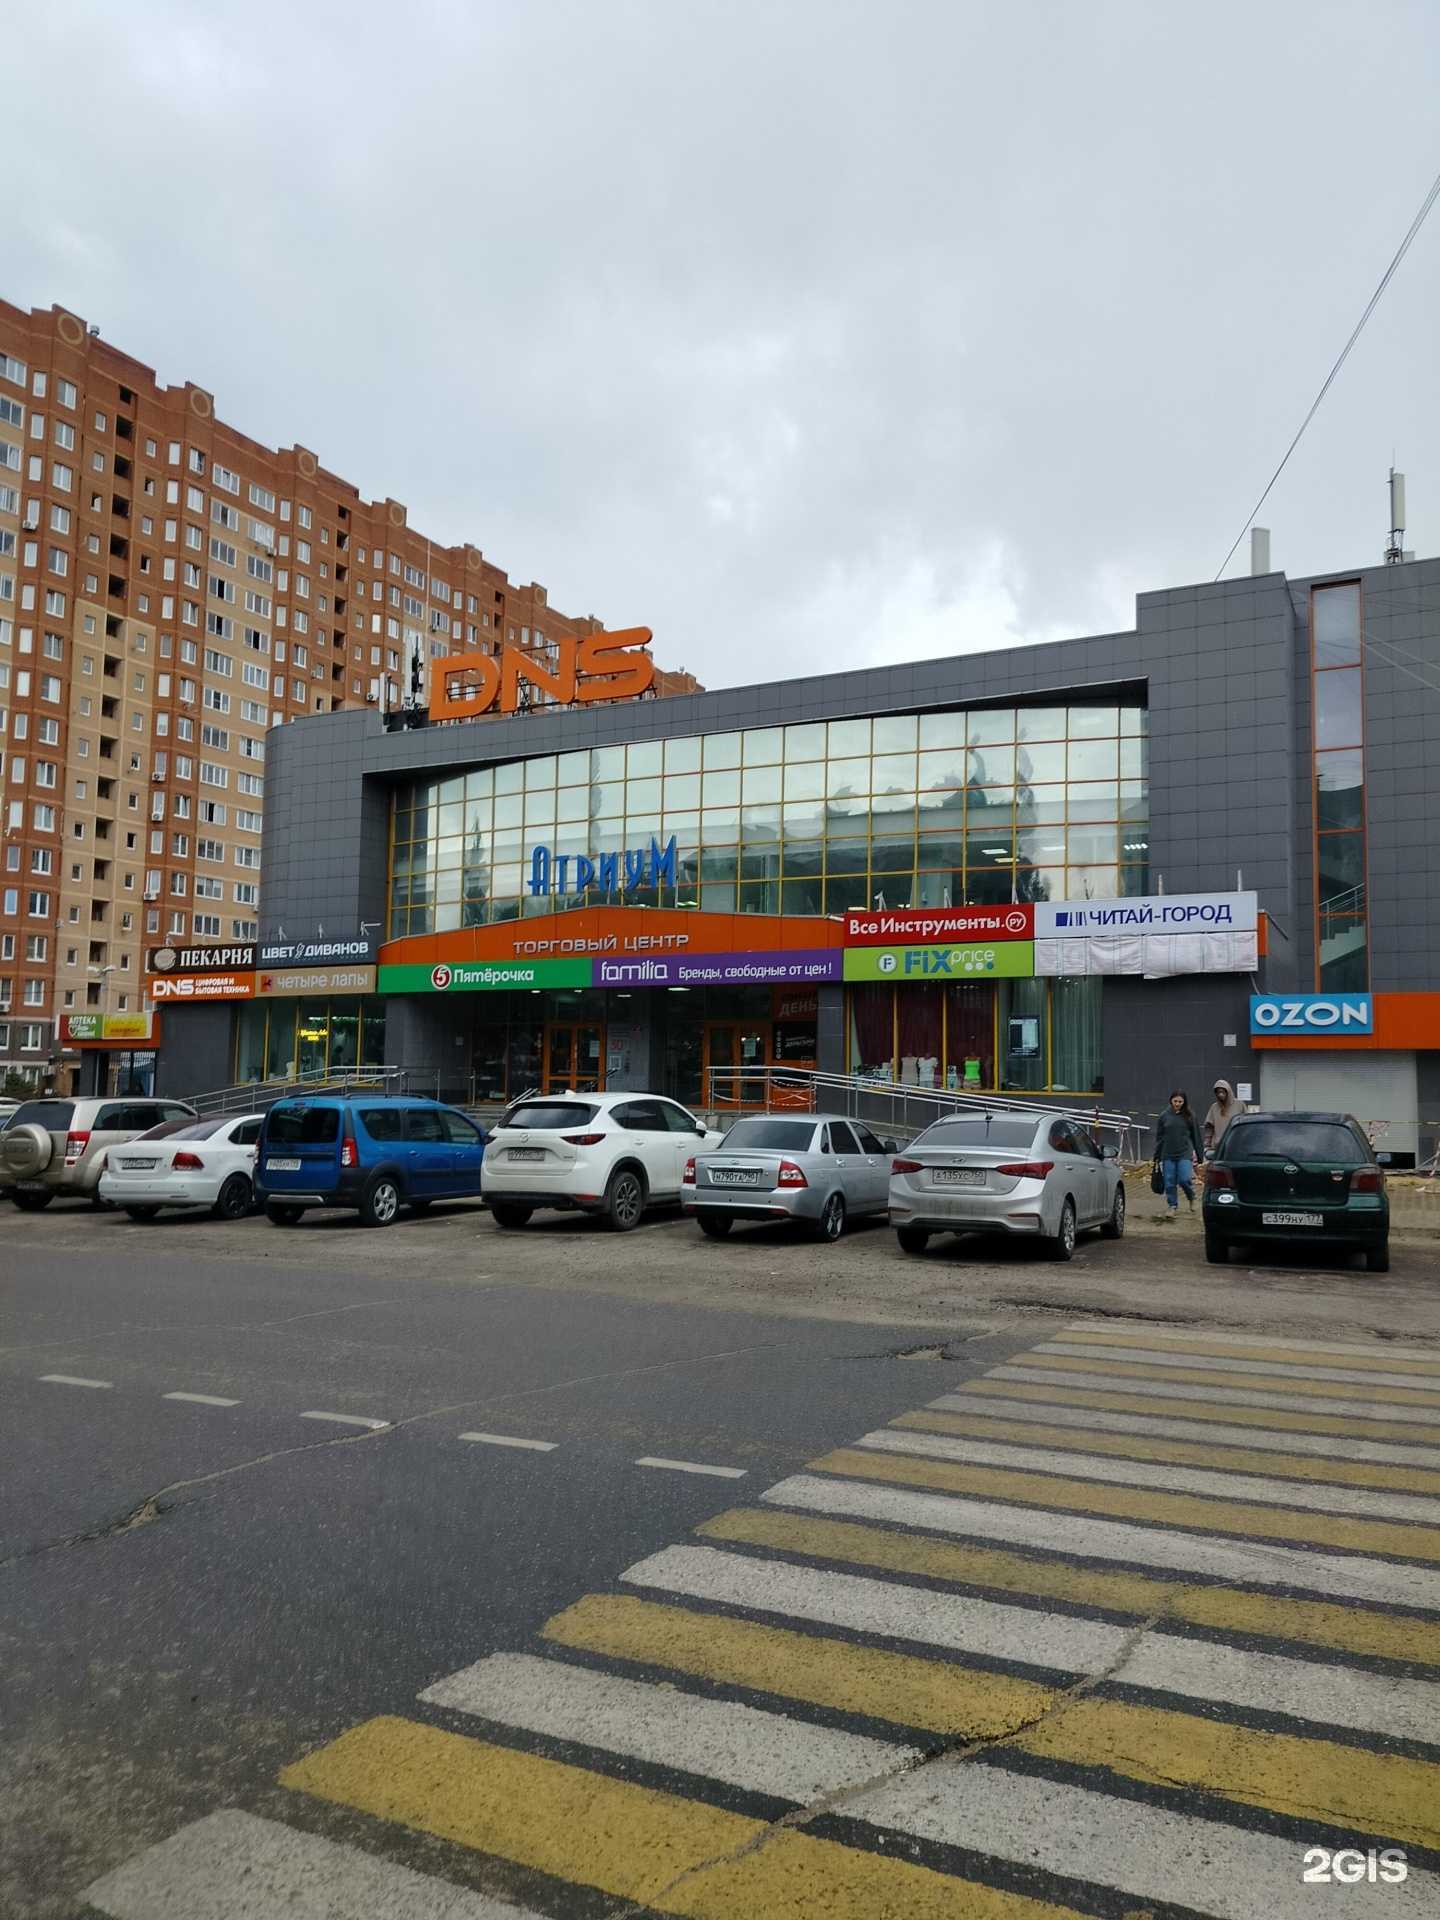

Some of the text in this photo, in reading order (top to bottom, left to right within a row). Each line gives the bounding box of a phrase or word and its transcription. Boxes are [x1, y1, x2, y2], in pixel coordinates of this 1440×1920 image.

[428, 626, 656, 720] DNS
[1090, 904, 1232, 926] ЧИТАЙ-ГОРОД
[850, 919, 878, 934] Все
[262, 946, 295, 959] ЦВЕТ
[304, 942, 369, 957] ДИВАНОВ
[513, 934, 689, 954] ТОРГОВЫЙ ЦЕНТР
[180, 947, 253, 966] ПЕКАРНЯ
[951, 949, 995, 964] price
[454, 968, 534, 984] Пятёрочка
[601, 960, 668, 980] familia
[678, 967, 722, 980] Бренды,
[725, 964, 787, 979] свободные
[789, 965, 802, 975] от
[153, 979, 194, 996] DNS
[68, 1016, 96, 1025] АПТЕКА
[1255, 1002, 1367, 1026] OZON
